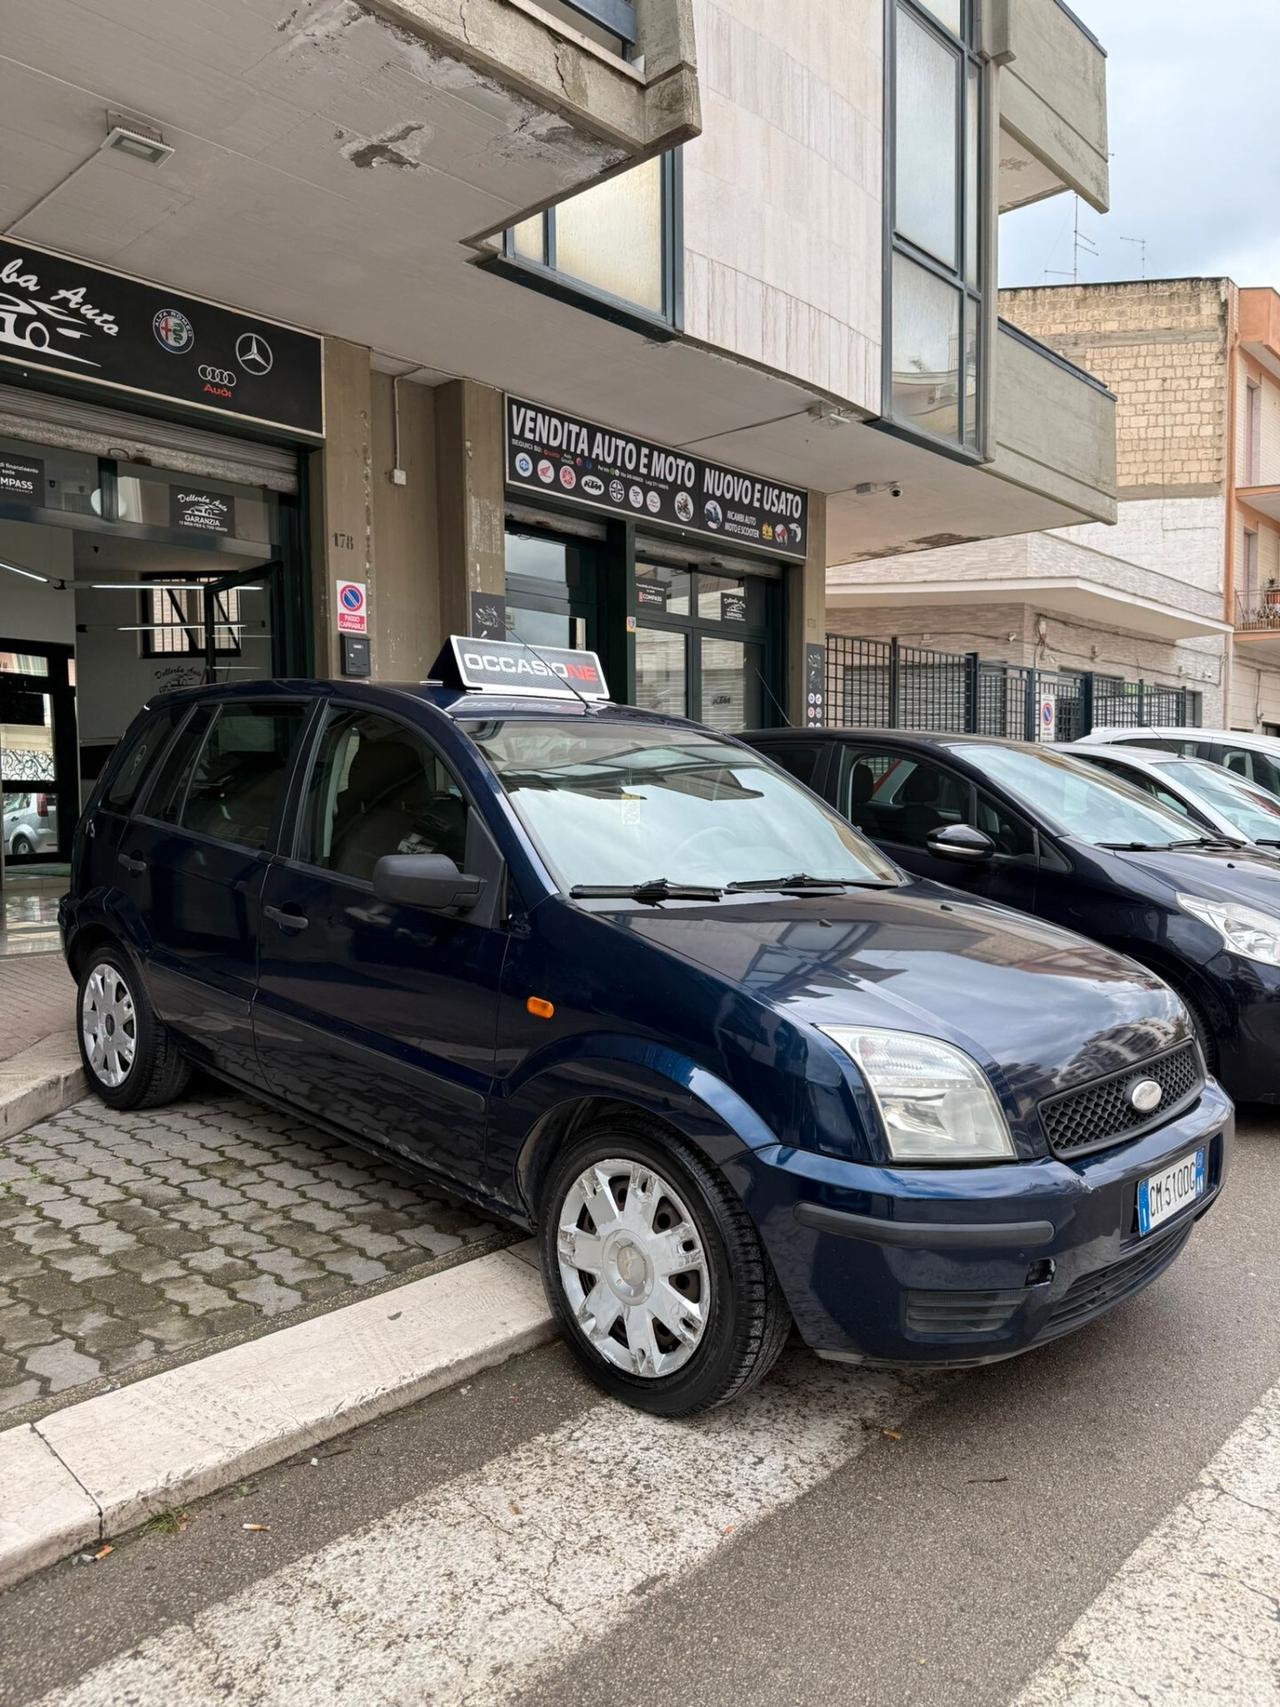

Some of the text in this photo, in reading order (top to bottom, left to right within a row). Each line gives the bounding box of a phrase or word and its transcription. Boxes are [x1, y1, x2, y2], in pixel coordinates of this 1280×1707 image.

[50, 287, 119, 336] Auto
[203, 383, 232, 398] Audi
[512, 404, 589, 457] VENDITA
[591, 432, 637, 470] AUTO
[639, 446, 650, 474] E
[651, 450, 695, 488] MOTO
[703, 467, 752, 505] NUOVO
[753, 482, 762, 508] E
[763, 485, 802, 519] USATO
[583, 478, 602, 492] KTM
[184, 514, 221, 526] GARANZIA
[463, 654, 598, 683] OCCASIONE
